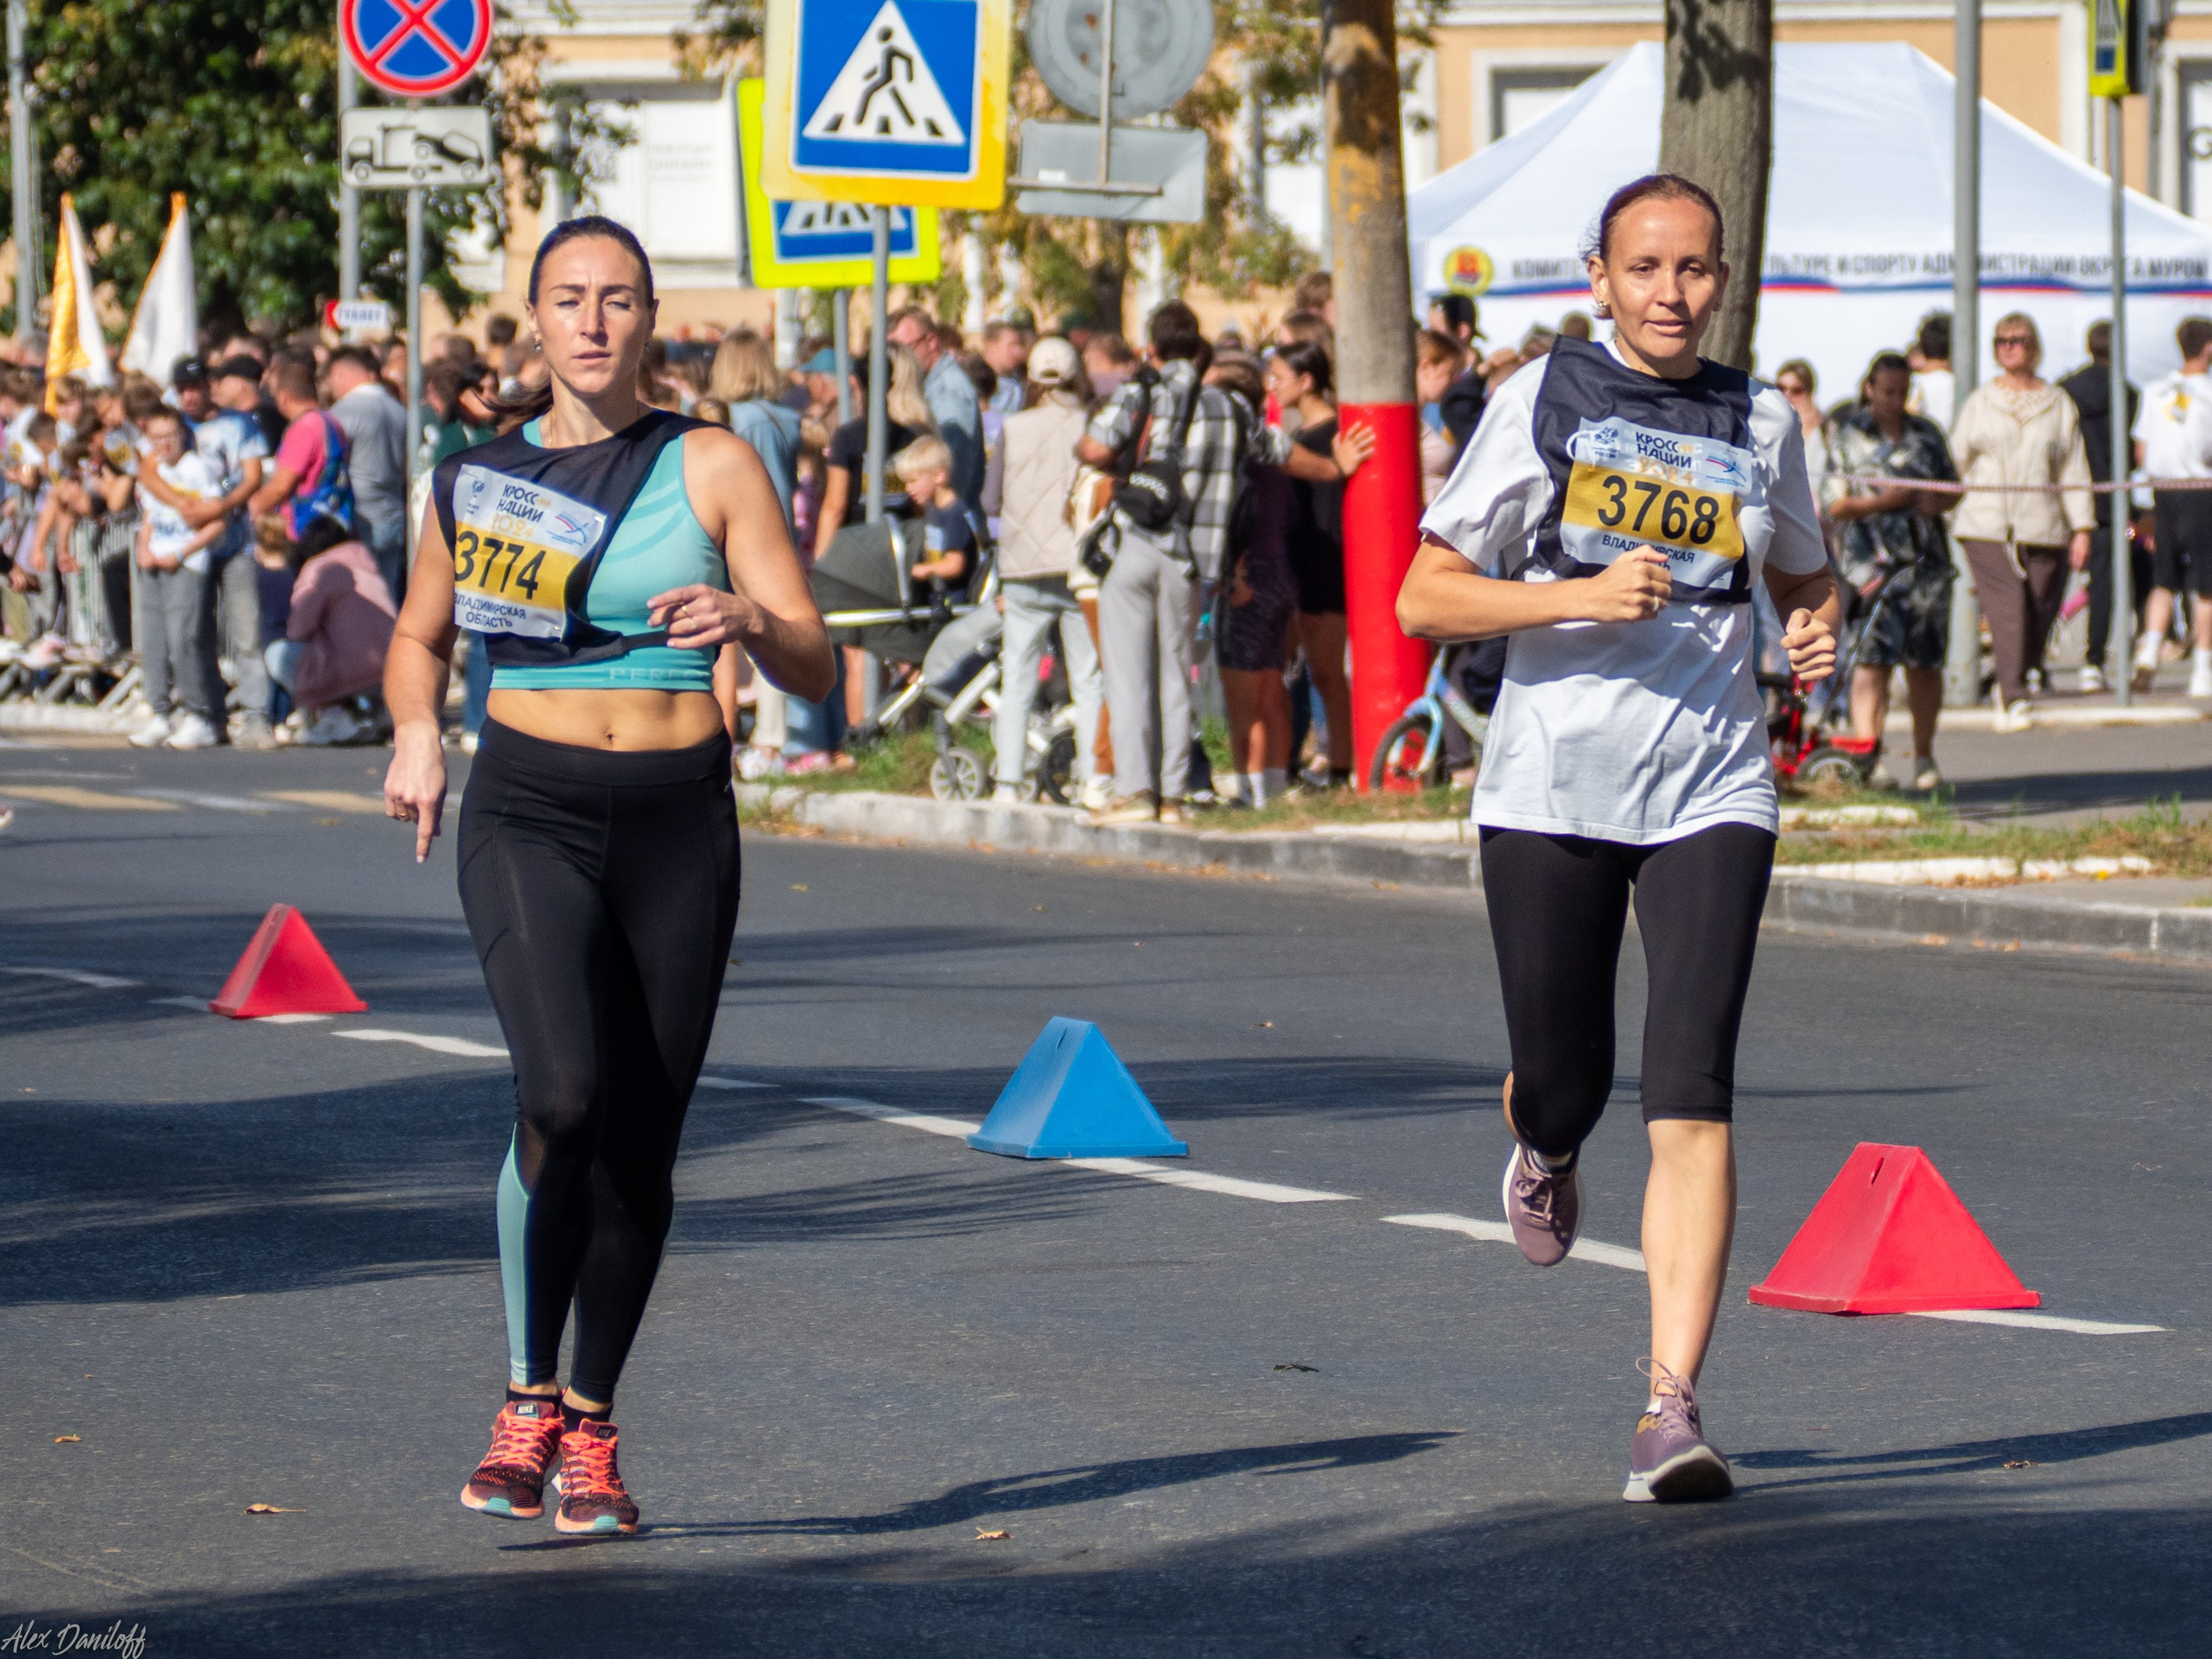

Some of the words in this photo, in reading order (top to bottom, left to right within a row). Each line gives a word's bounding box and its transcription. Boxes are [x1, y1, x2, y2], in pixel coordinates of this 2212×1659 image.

[1512, 257, 1583, 279] КОМИТЕ
[1635, 431, 1679, 454] КРОСС
[1637, 443, 1692, 469] НАЦИИ
[502, 484, 539, 505] КРОСС
[496, 499, 544, 523] НАЦИИ
[1598, 474, 1719, 545] 3768
[454, 531, 547, 601] 3774
[466, 611, 513, 628] ОБЛАСТЬ
[517, 1404, 535, 1414] NIKE
